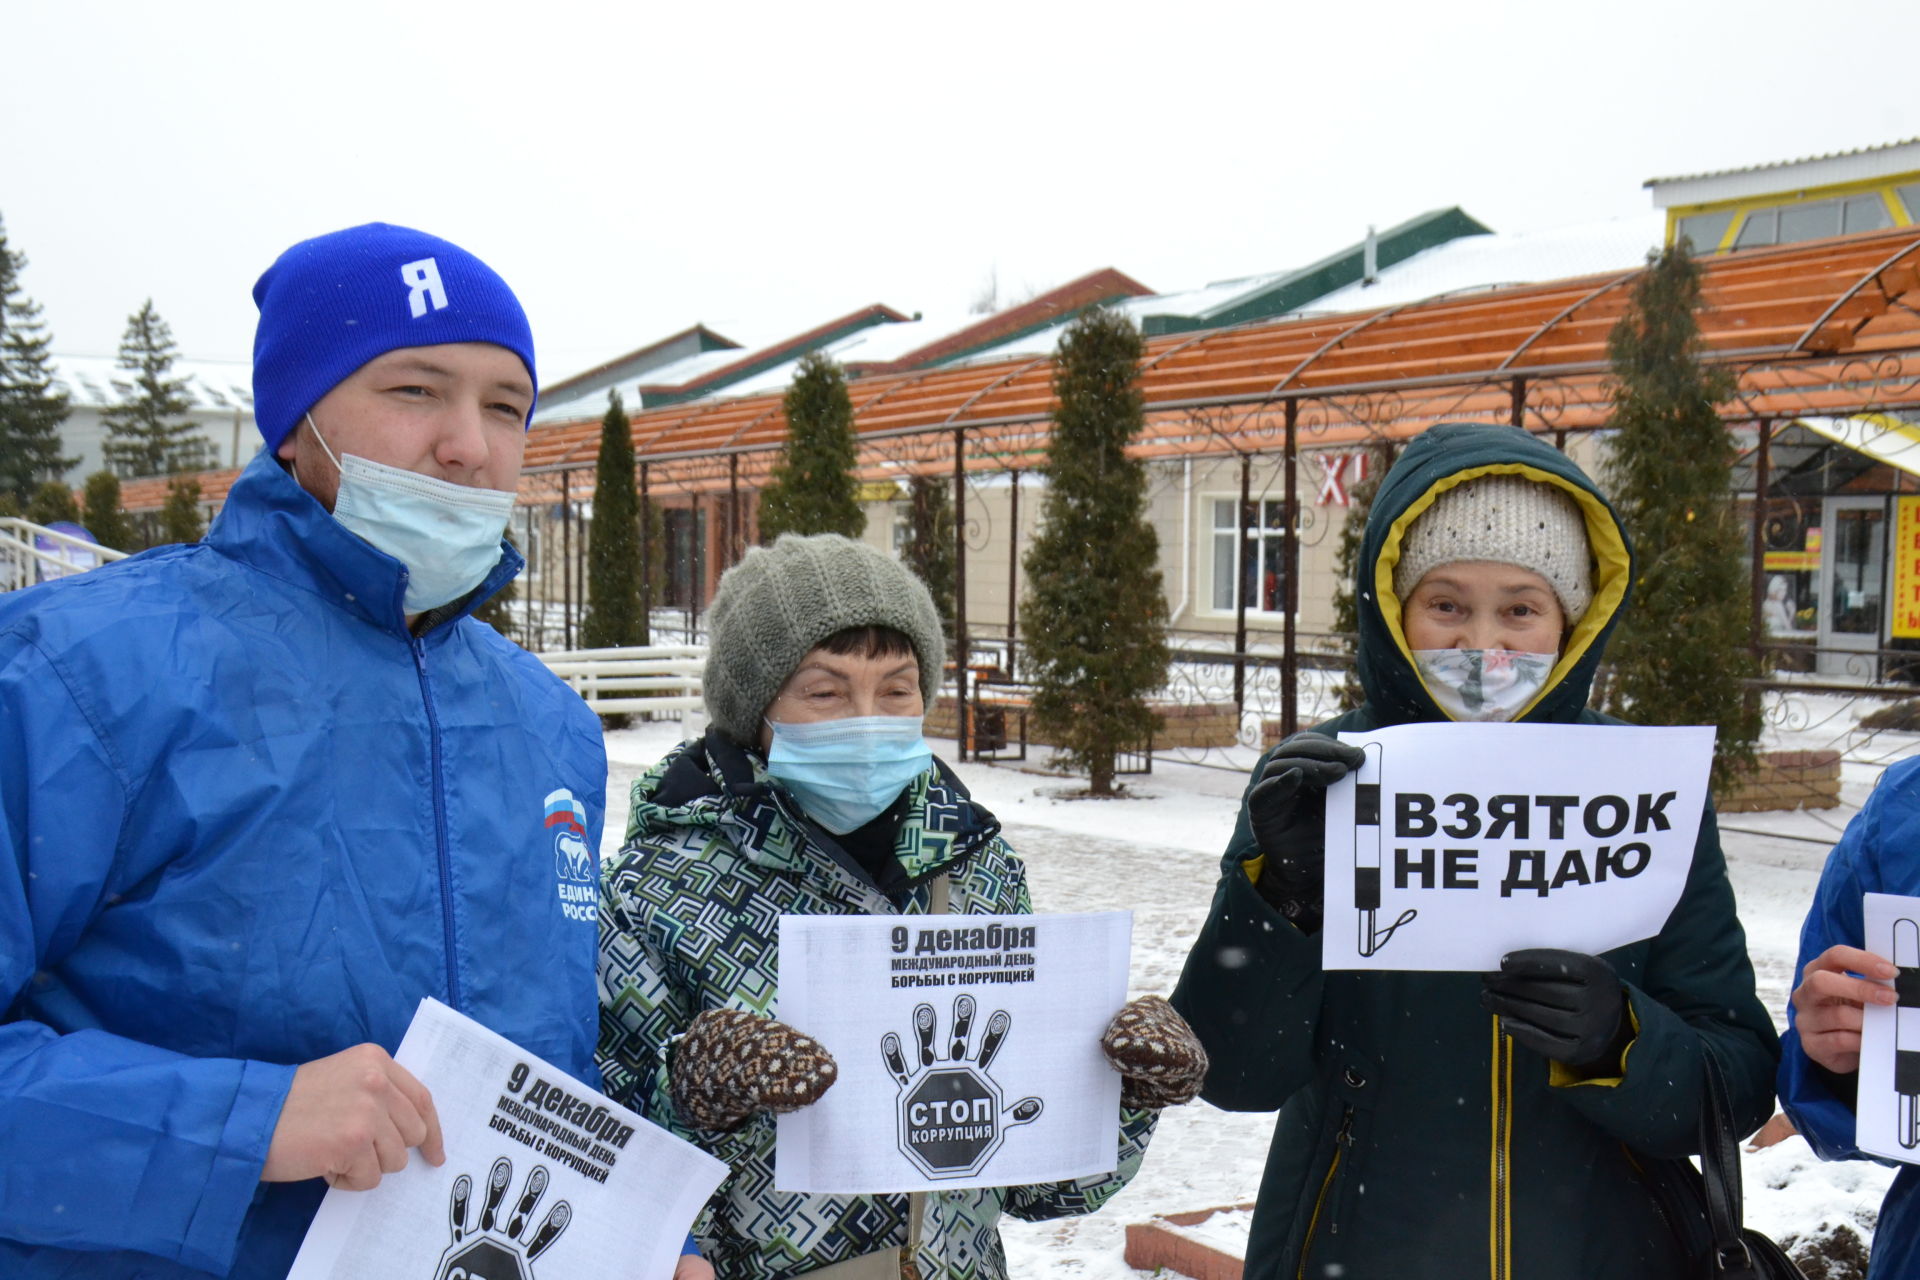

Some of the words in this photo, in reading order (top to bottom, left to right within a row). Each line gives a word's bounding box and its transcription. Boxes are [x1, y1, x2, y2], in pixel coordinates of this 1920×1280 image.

[401, 257, 448, 319] Я
[1394, 791, 1678, 840] ВЗЯТОК
[1394, 848, 1479, 890] НЕ
[1500, 842, 1652, 898] ДАЮ
[561, 902, 598, 921] РОСС
[891, 926, 909, 953] 9
[914, 923, 1036, 956] декабря
[891, 953, 1002, 972] МЕЖДУНАРОДНЫЙ
[1003, 953, 1035, 968] ДЕНЬ
[891, 973, 945, 988] БОРЬБЫ
[947, 973, 956, 986] С
[958, 968, 1035, 985] КОРРУПЦИЕЙ
[507, 1062, 530, 1094] 9
[523, 1078, 636, 1149] декабря
[909, 1097, 991, 1127] СТОП
[488, 1114, 537, 1148] БОРЬБЫ
[535, 1137, 545, 1152] С
[543, 1142, 610, 1184] КОРРУПЦИЕЙ
[497, 1095, 592, 1153] МЕЖДУНАРОДНЫЙ
[587, 1142, 617, 1167] ДЕНЬ
[911, 1124, 992, 1144] КОРРУПЦИЯ
